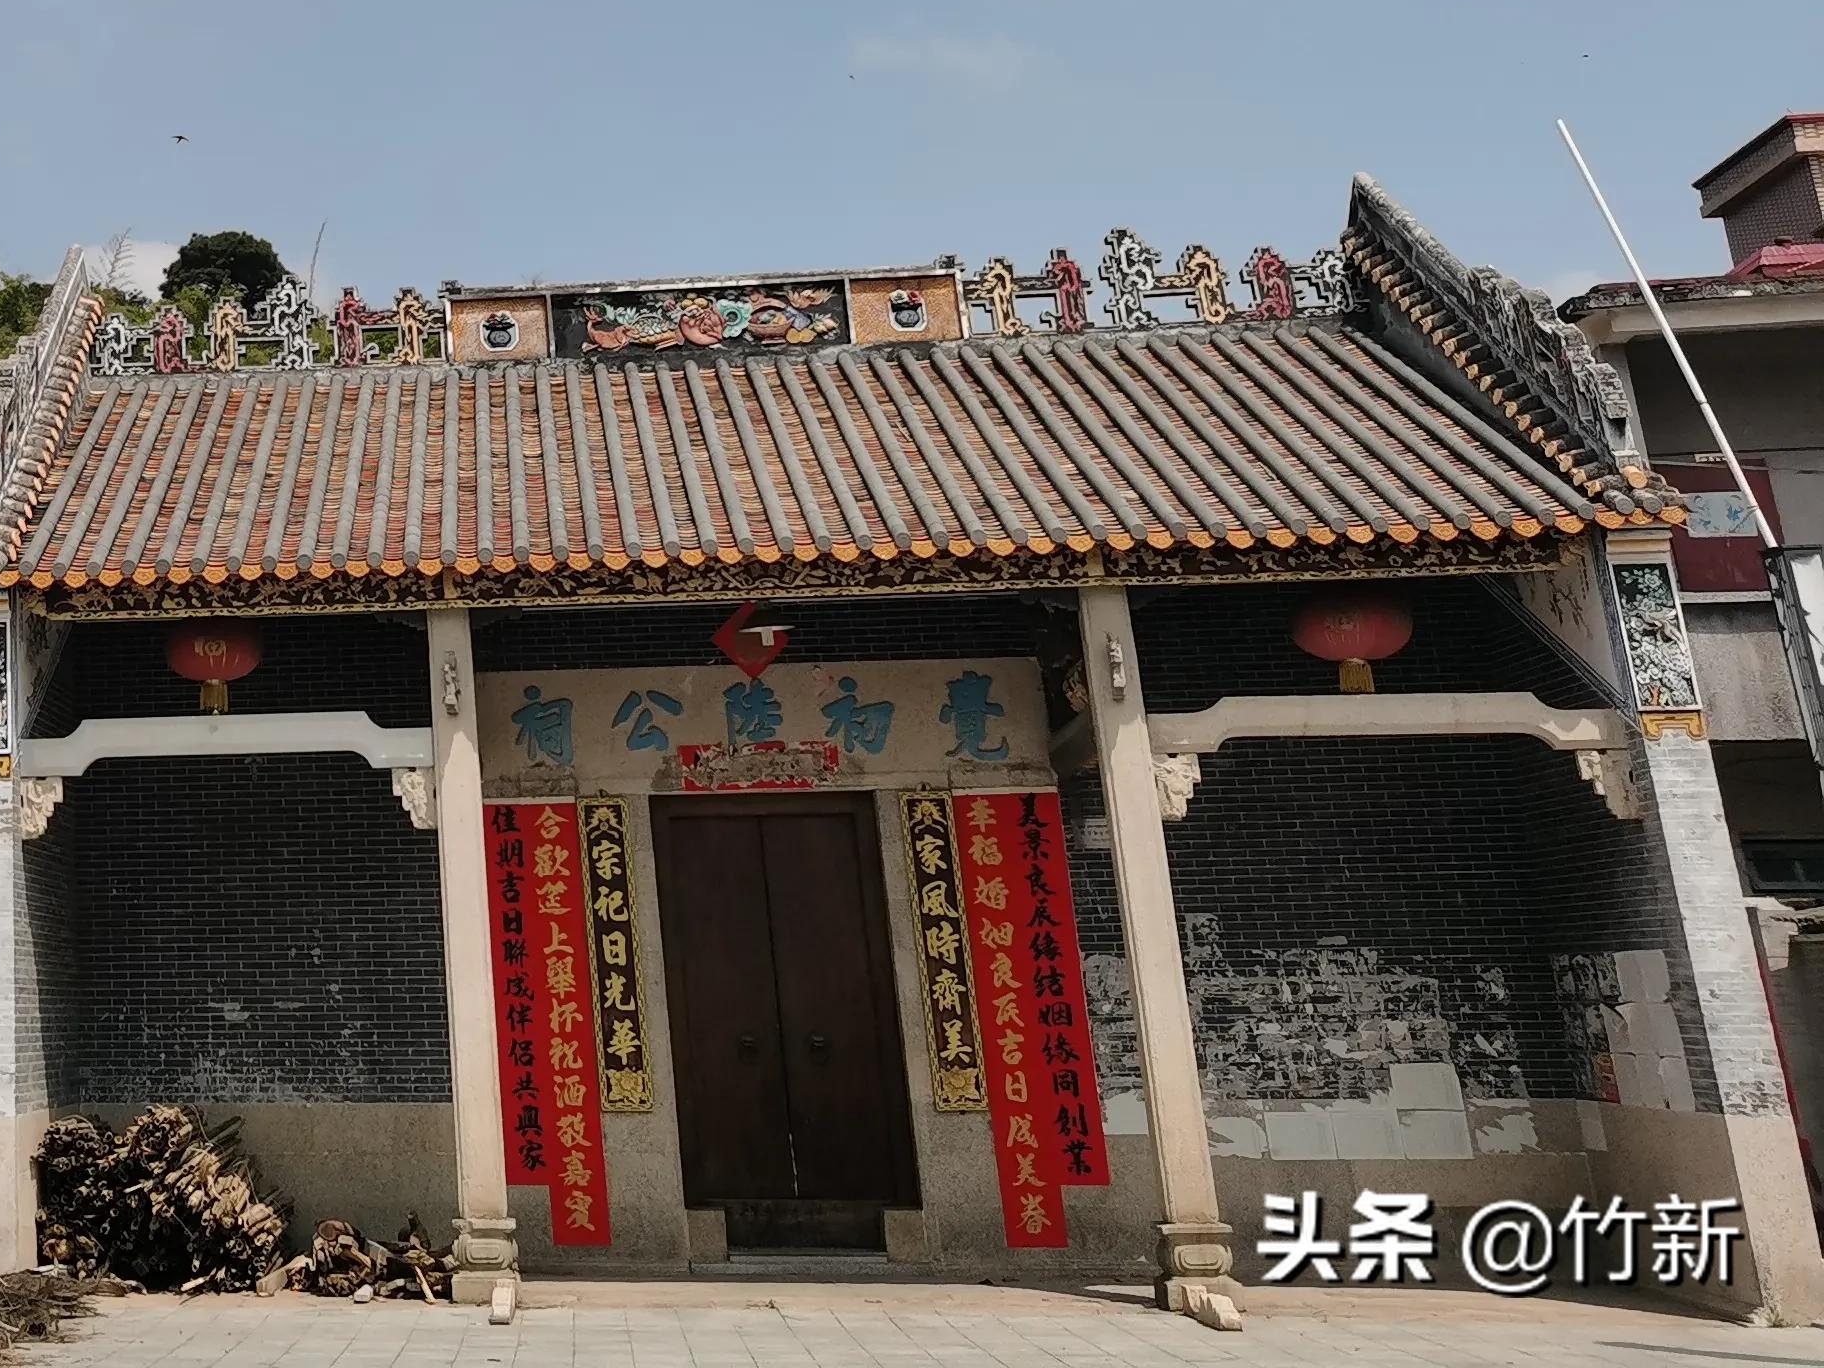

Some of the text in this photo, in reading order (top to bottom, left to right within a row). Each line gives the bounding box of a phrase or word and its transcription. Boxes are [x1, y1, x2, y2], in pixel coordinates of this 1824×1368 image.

[592, 839, 641, 1065] 宗祀日光華
